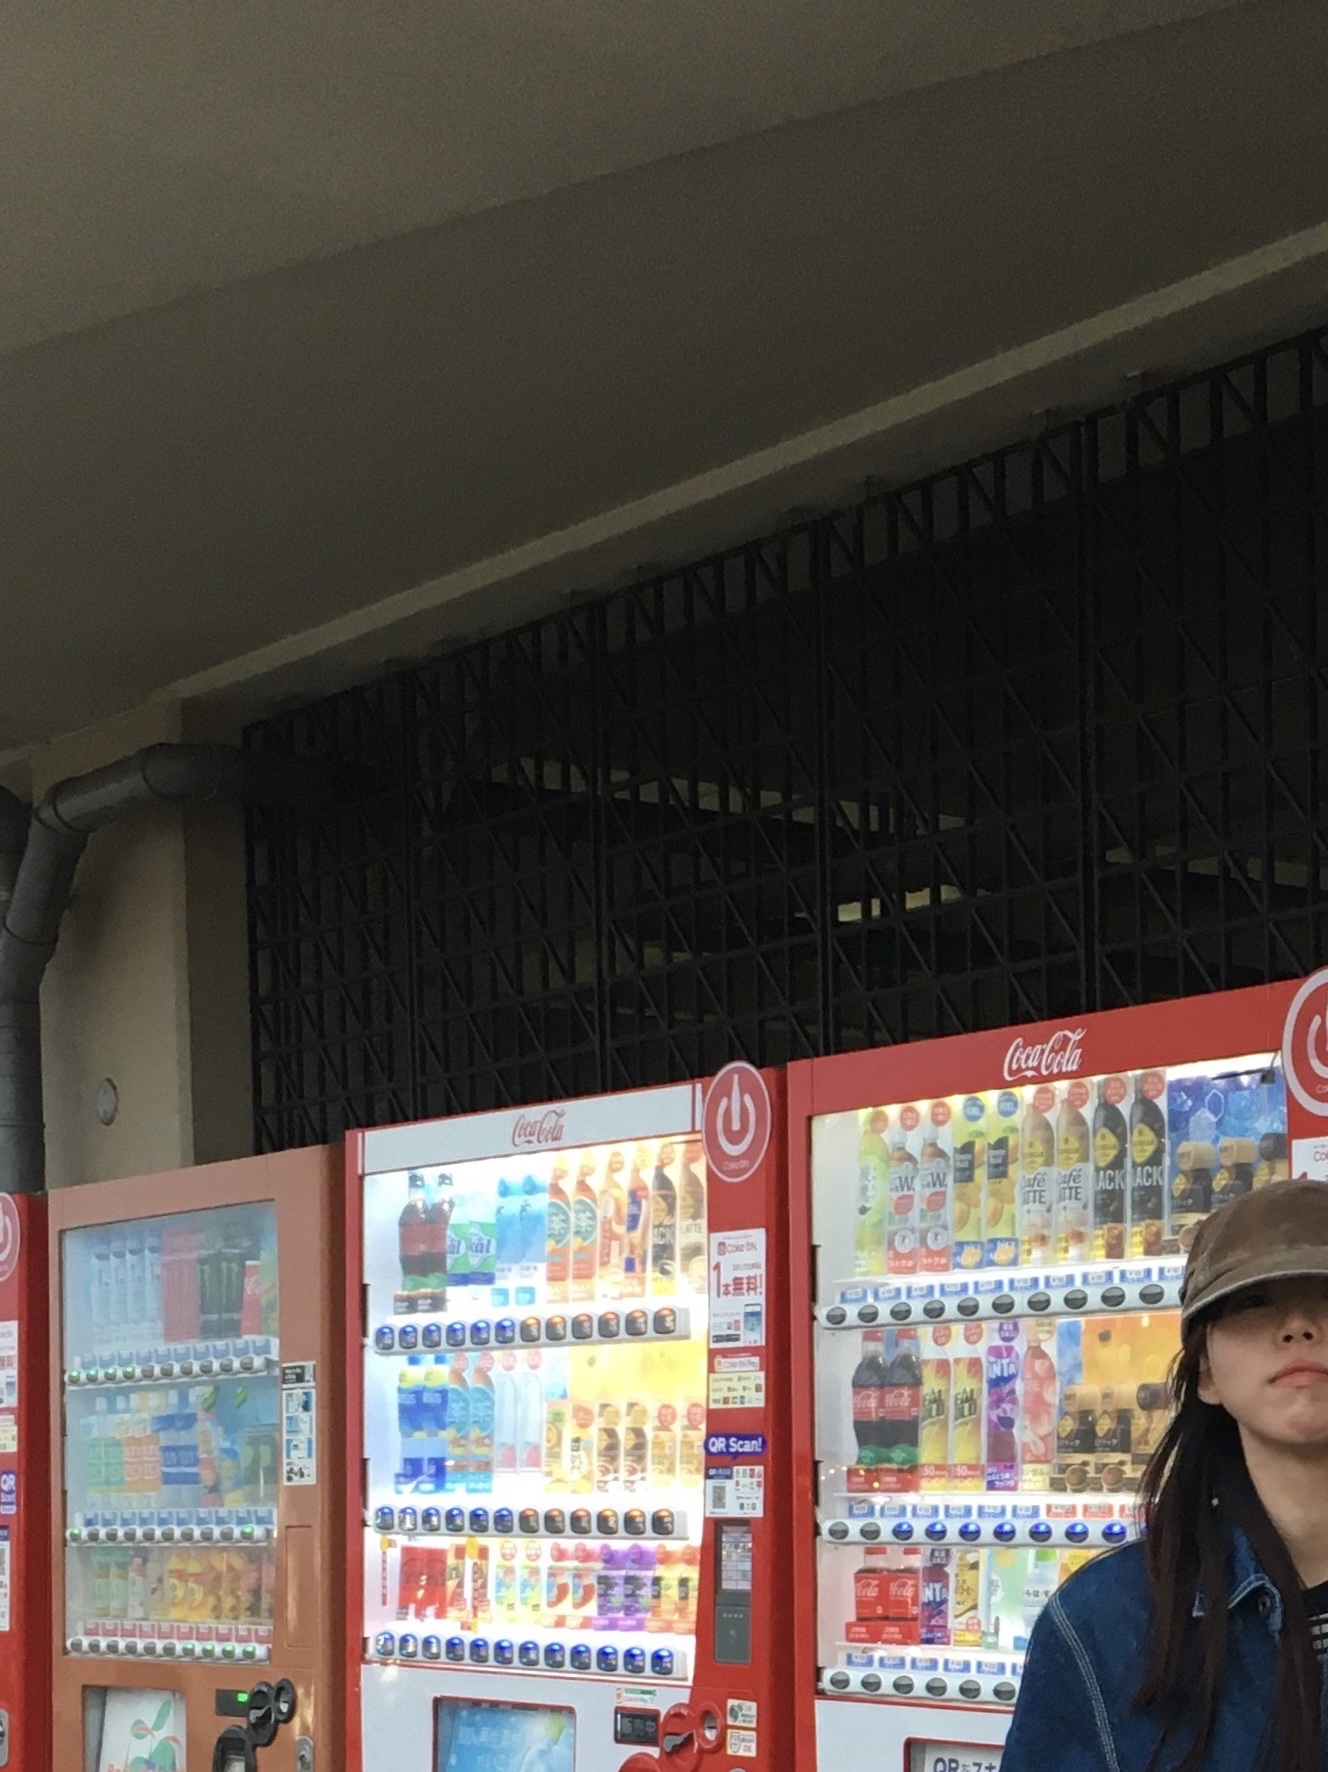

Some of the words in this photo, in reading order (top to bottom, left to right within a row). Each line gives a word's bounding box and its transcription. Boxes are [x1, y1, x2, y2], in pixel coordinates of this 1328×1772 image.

[1003, 1028, 1087, 1082] Coca-Cola
[511, 1108, 567, 1148] Coca-Cola
[708, 1437, 726, 1453] QR
[728, 1436, 763, 1453] Scan!
